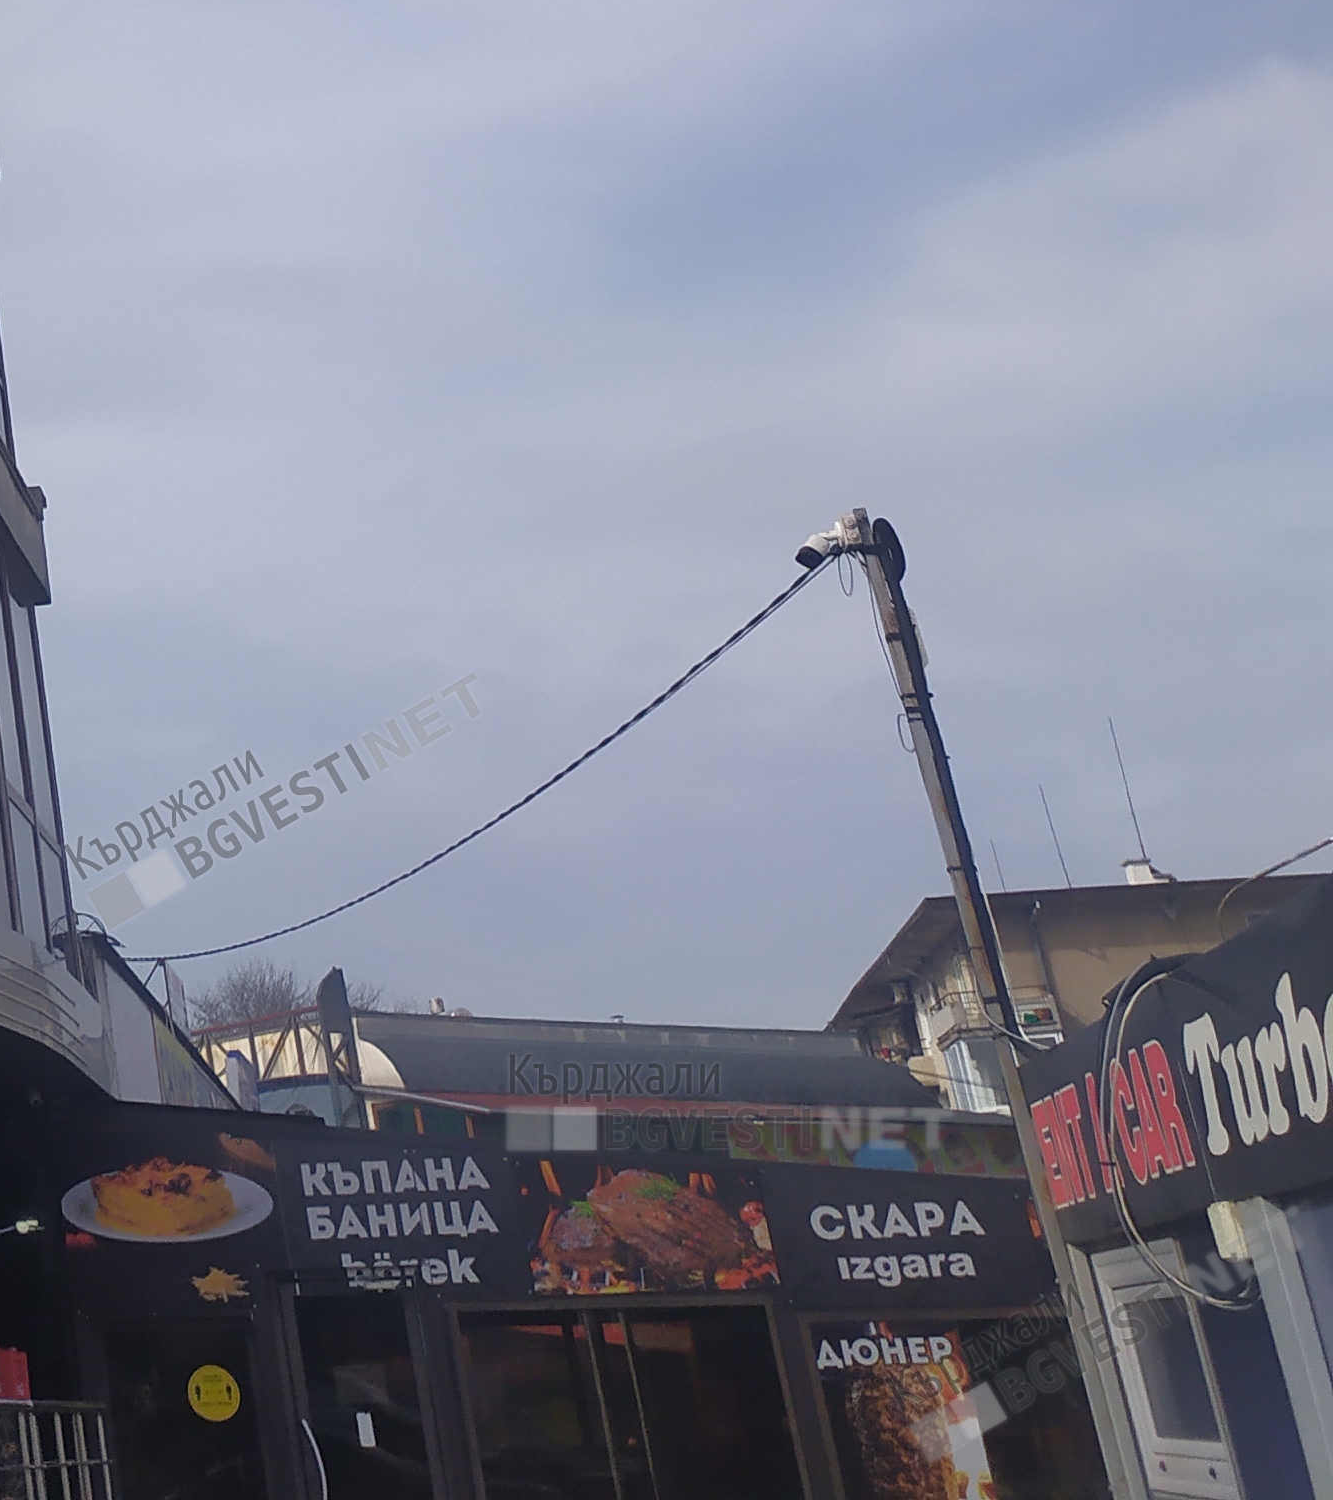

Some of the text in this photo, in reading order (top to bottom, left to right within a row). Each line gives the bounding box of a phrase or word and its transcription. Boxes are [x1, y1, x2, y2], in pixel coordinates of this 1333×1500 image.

[1183, 971, 1333, 1156] Turb
[1030, 1082, 1096, 1209] ENT
[1109, 1038, 1197, 1186] CAR
[300, 1155, 491, 1197] КЪПАНА
[306, 1199, 500, 1241] БАНИЦА
[810, 1199, 987, 1241] СКАРА
[816, 1335, 953, 1370] ДЮНЕР
